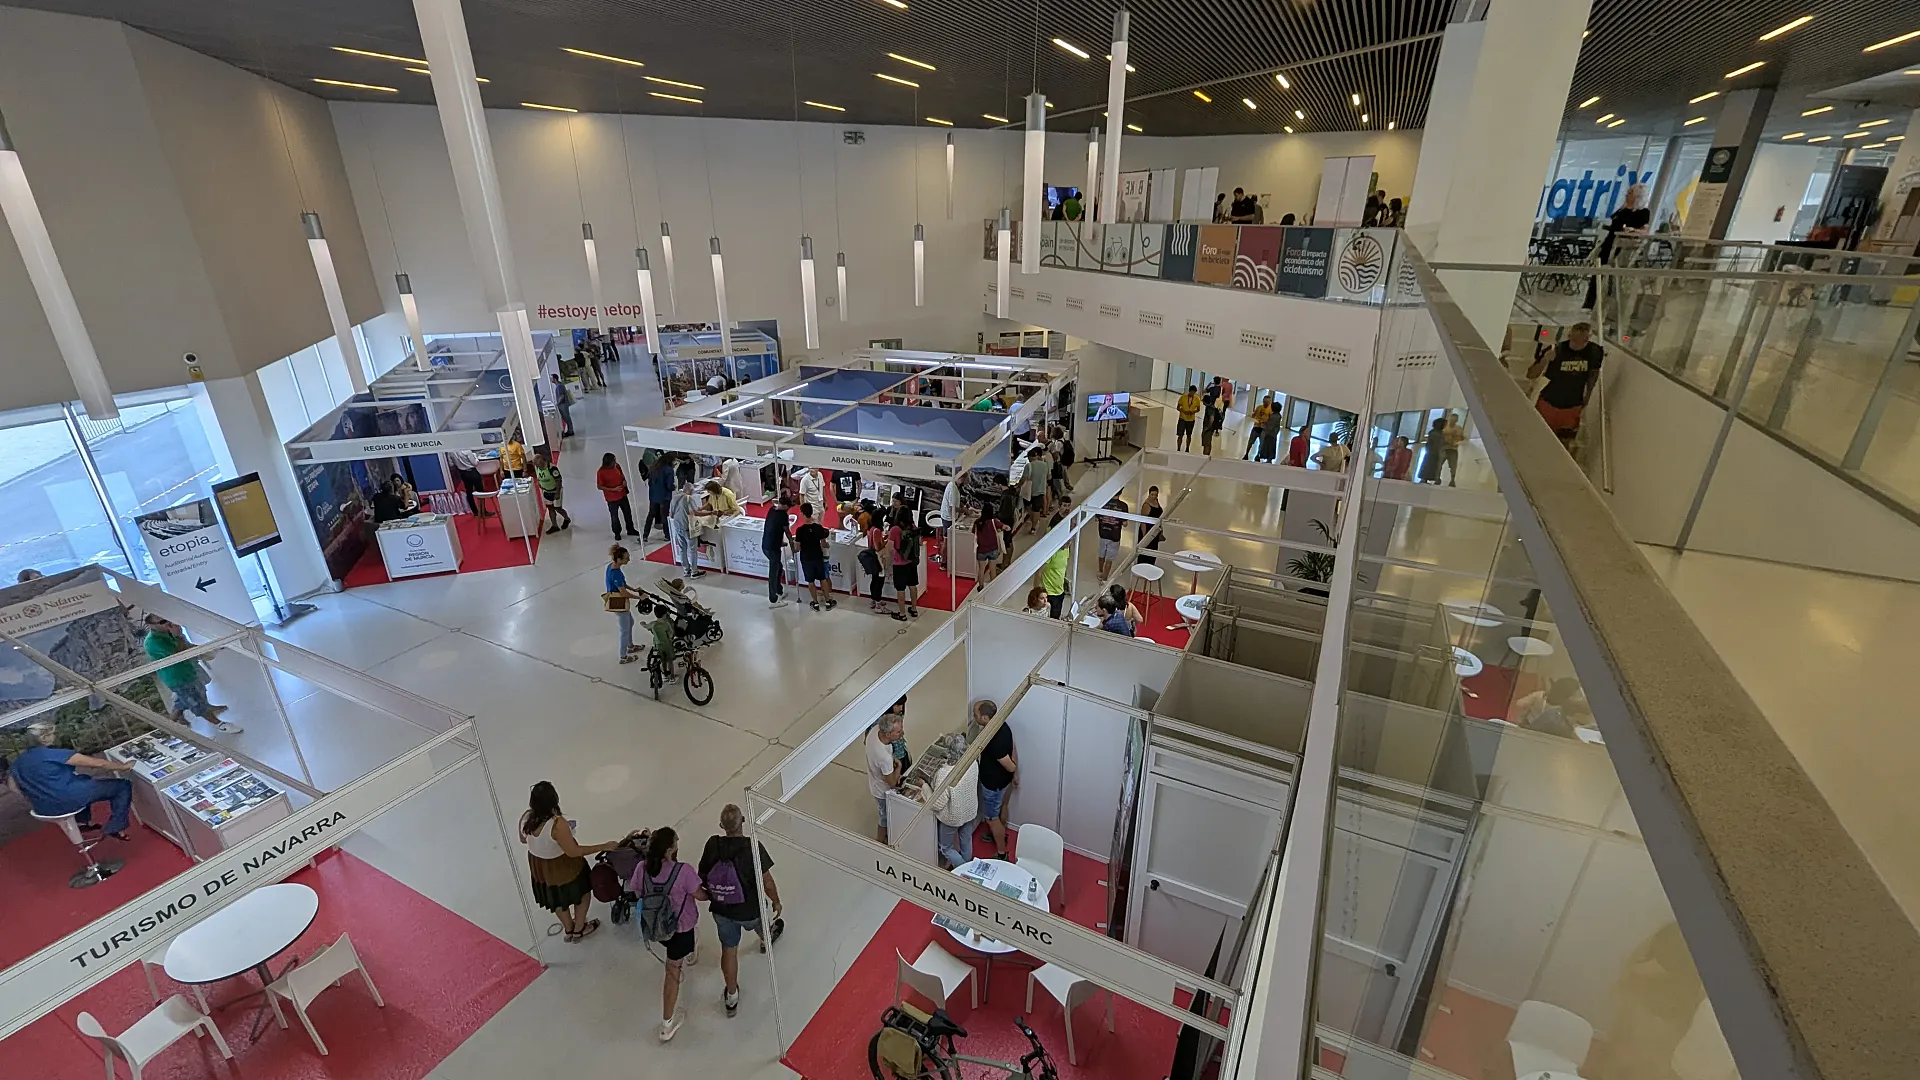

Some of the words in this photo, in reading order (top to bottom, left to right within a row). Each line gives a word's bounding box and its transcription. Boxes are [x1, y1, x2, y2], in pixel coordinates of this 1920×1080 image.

[1202, 244, 1217, 255] Foro
[1285, 247, 1301, 257] Foro
[1314, 258, 1325, 266] del
[1283, 265, 1324, 276] cicloturismo
[363, 444, 396, 452] REGION
[397, 442, 409, 450] DE
[410, 440, 442, 448] MURCIA
[831, 456, 860, 465] ARAGON
[862, 459, 893, 468] TURISMO
[70, 894, 197, 968] TURISMO
[202, 869, 238, 897] DE
[242, 811, 347, 874] NAVARRA
[875, 860, 897, 879] LA
[901, 873, 960, 906] PLANA
[965, 898, 989, 919] DE
